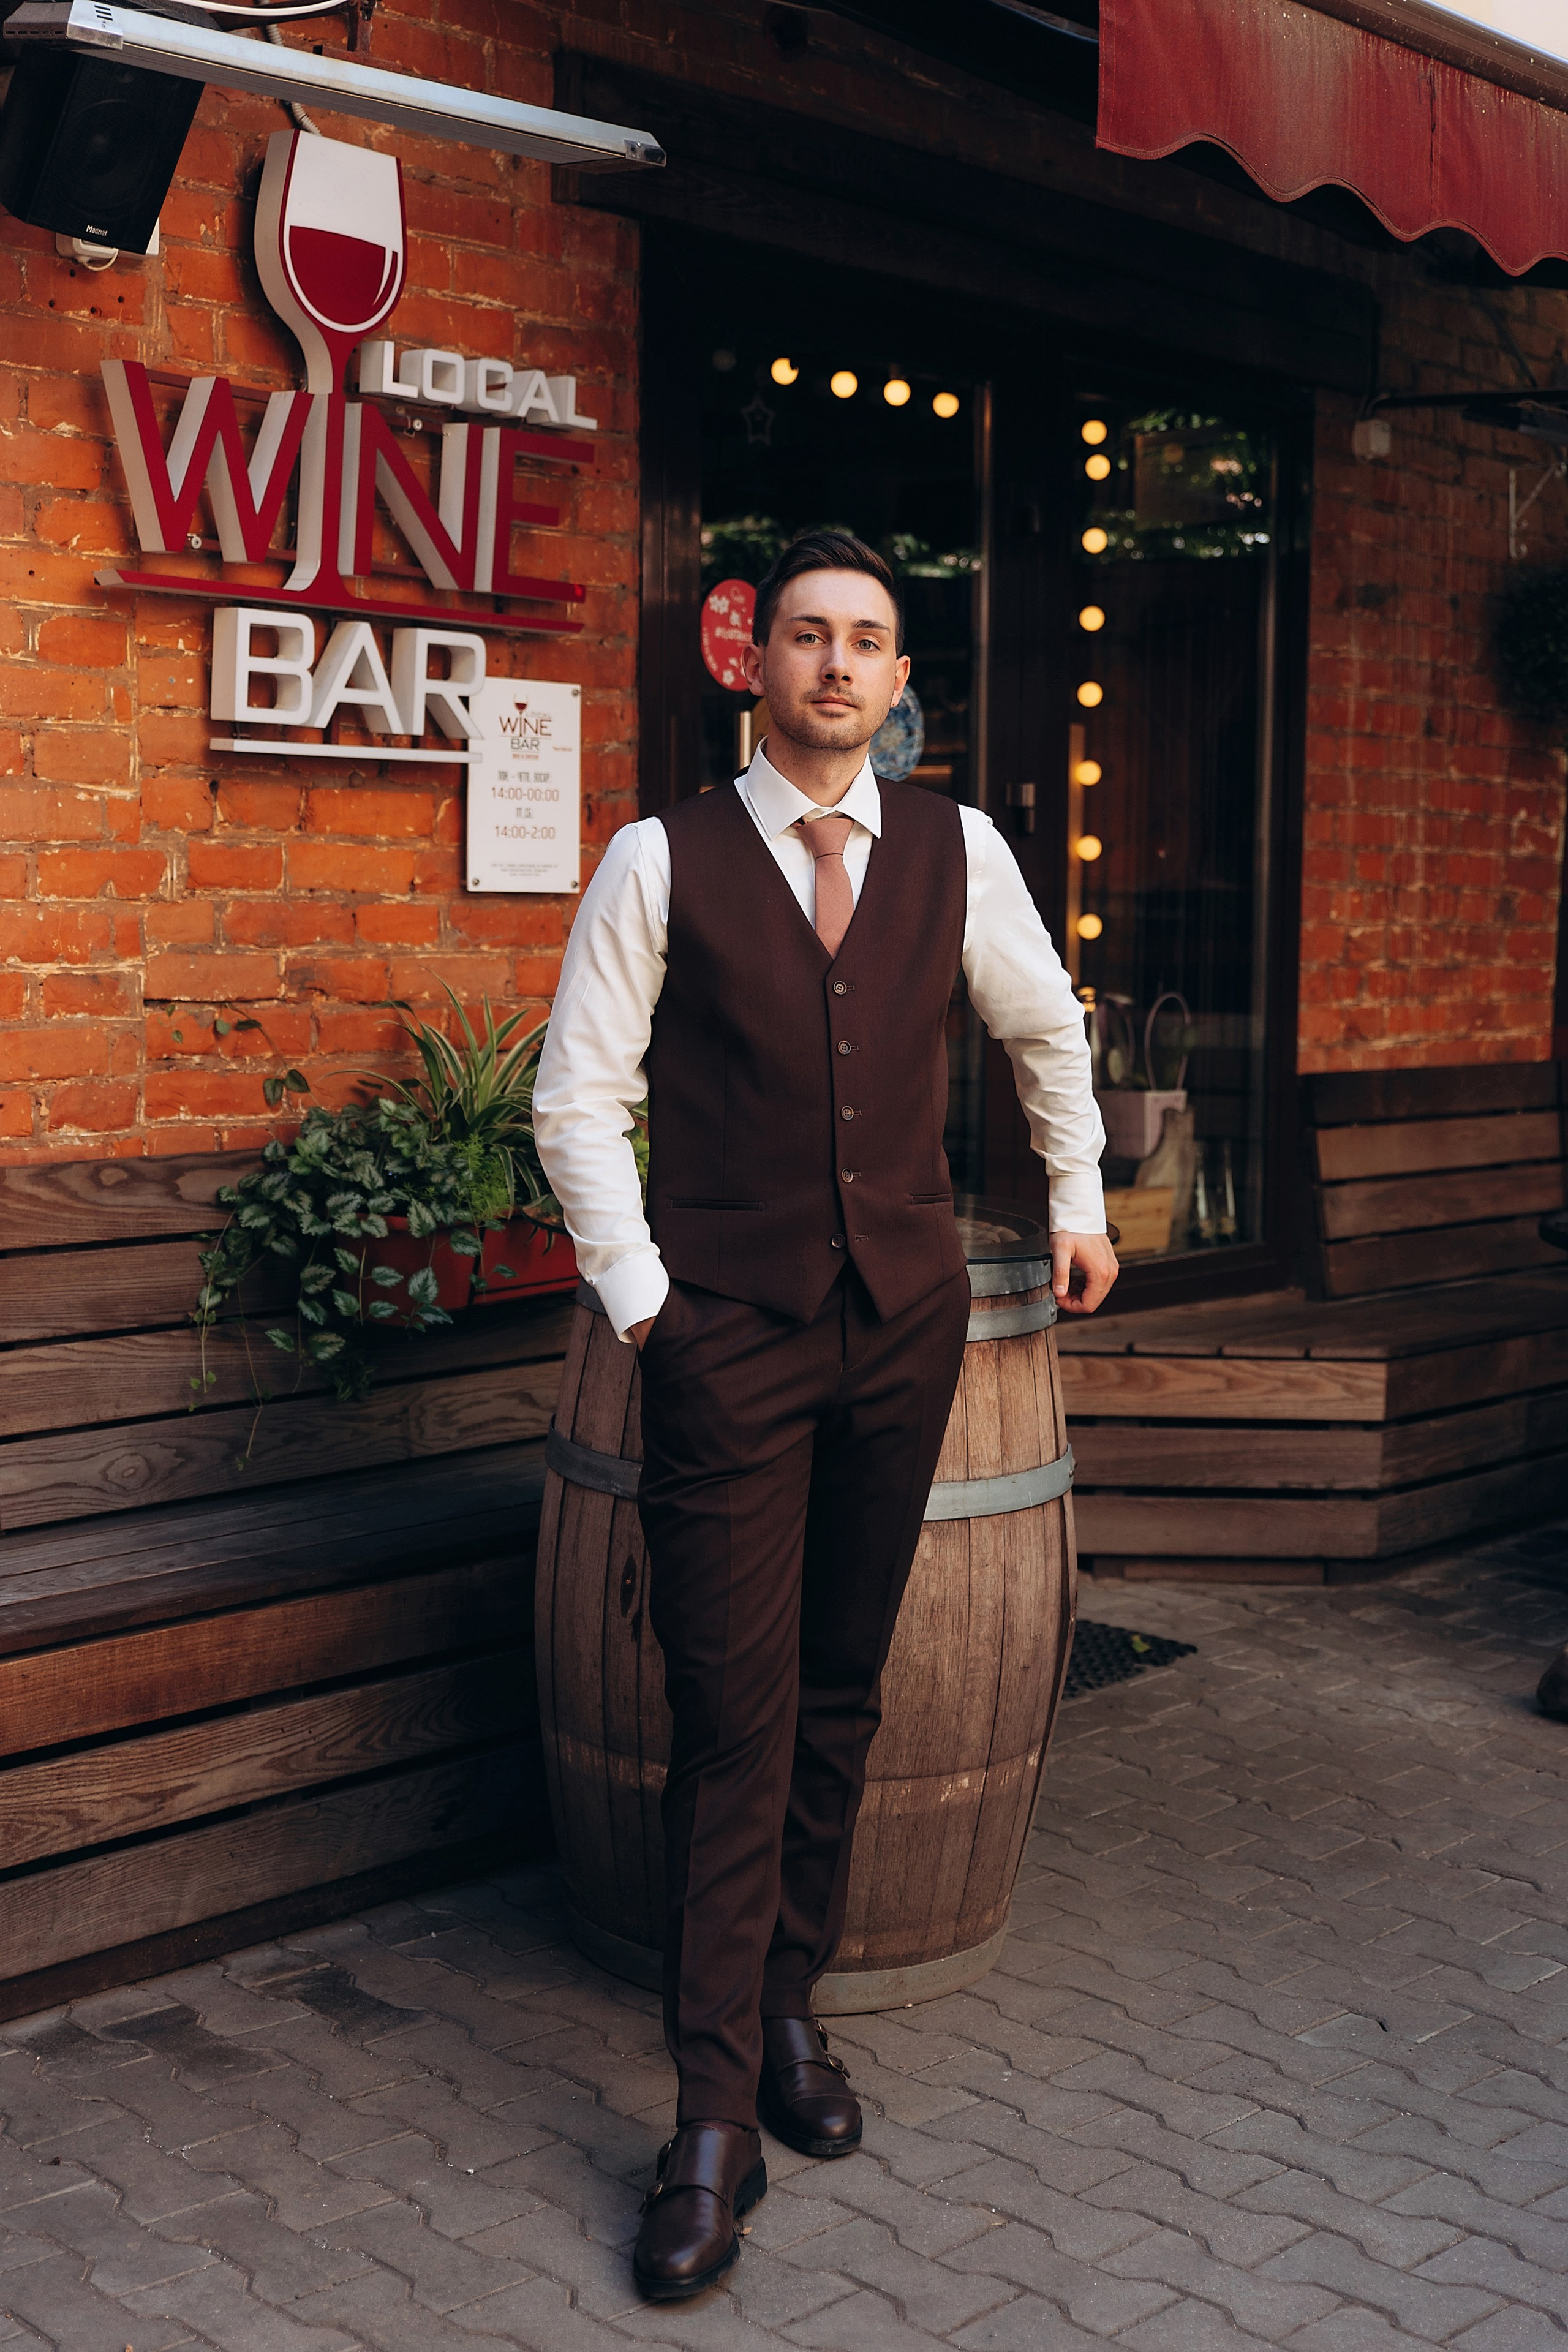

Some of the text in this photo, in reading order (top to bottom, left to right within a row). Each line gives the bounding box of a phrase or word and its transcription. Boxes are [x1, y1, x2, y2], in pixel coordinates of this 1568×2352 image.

[359, 341, 598, 431] LOCAL
[100, 359, 595, 603] WINE
[211, 606, 486, 739] BAR
[499, 716, 552, 737] WINE
[511, 737, 540, 751] BAR
[492, 787, 559, 802] 14:00-00:00
[496, 826, 556, 839] 14:00-2:00
